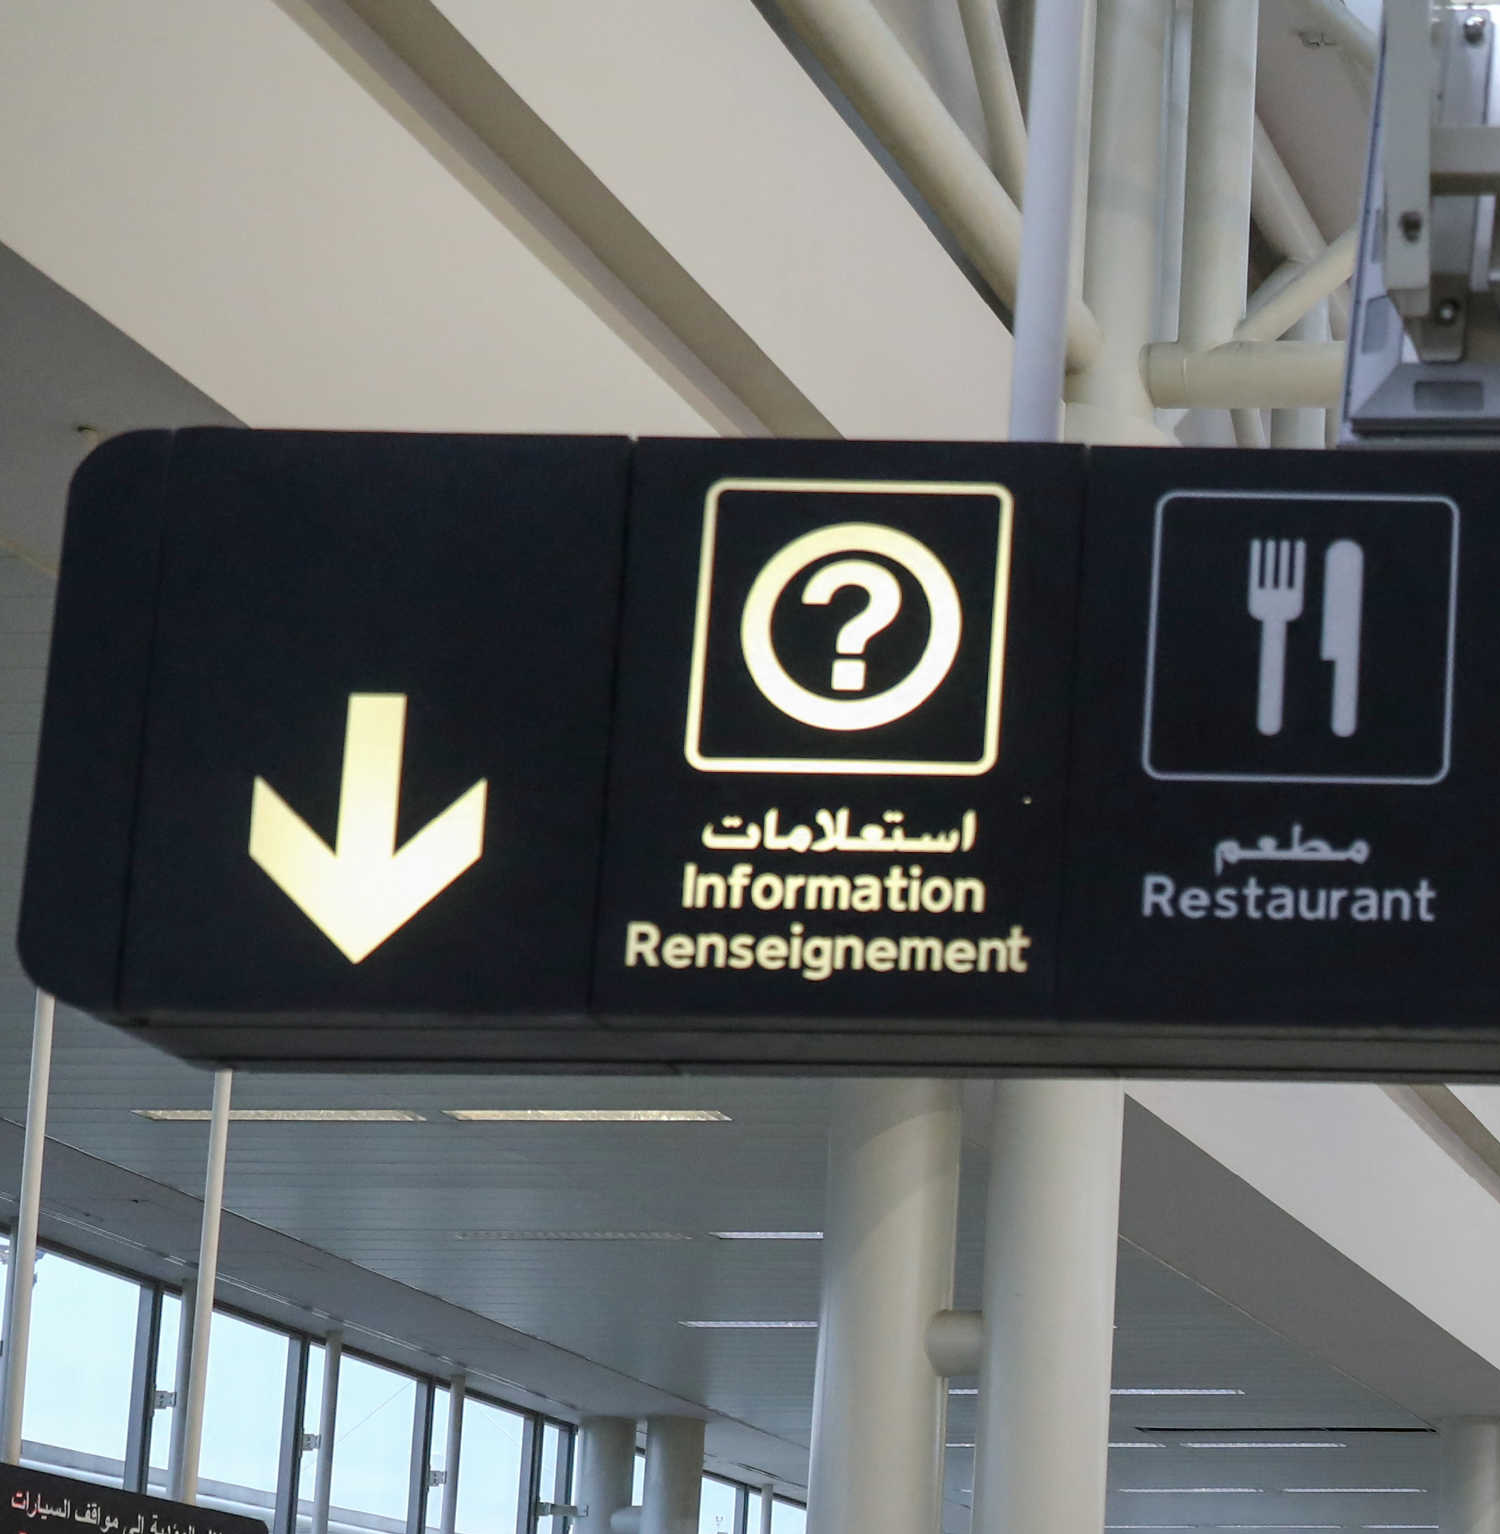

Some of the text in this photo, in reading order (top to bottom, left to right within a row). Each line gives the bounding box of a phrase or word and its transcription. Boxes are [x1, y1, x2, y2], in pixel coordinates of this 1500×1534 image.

[700, 807, 977, 853] استعلامات
[1213, 824, 1371, 877] مطعم
[681, 862, 986, 914] Information
[1142, 874, 1437, 923] Restaurant
[624, 921, 1032, 981] Renseignement
[11, 1490, 71, 1519] السيارات
[74, 1503, 119, 1532] مواقف
